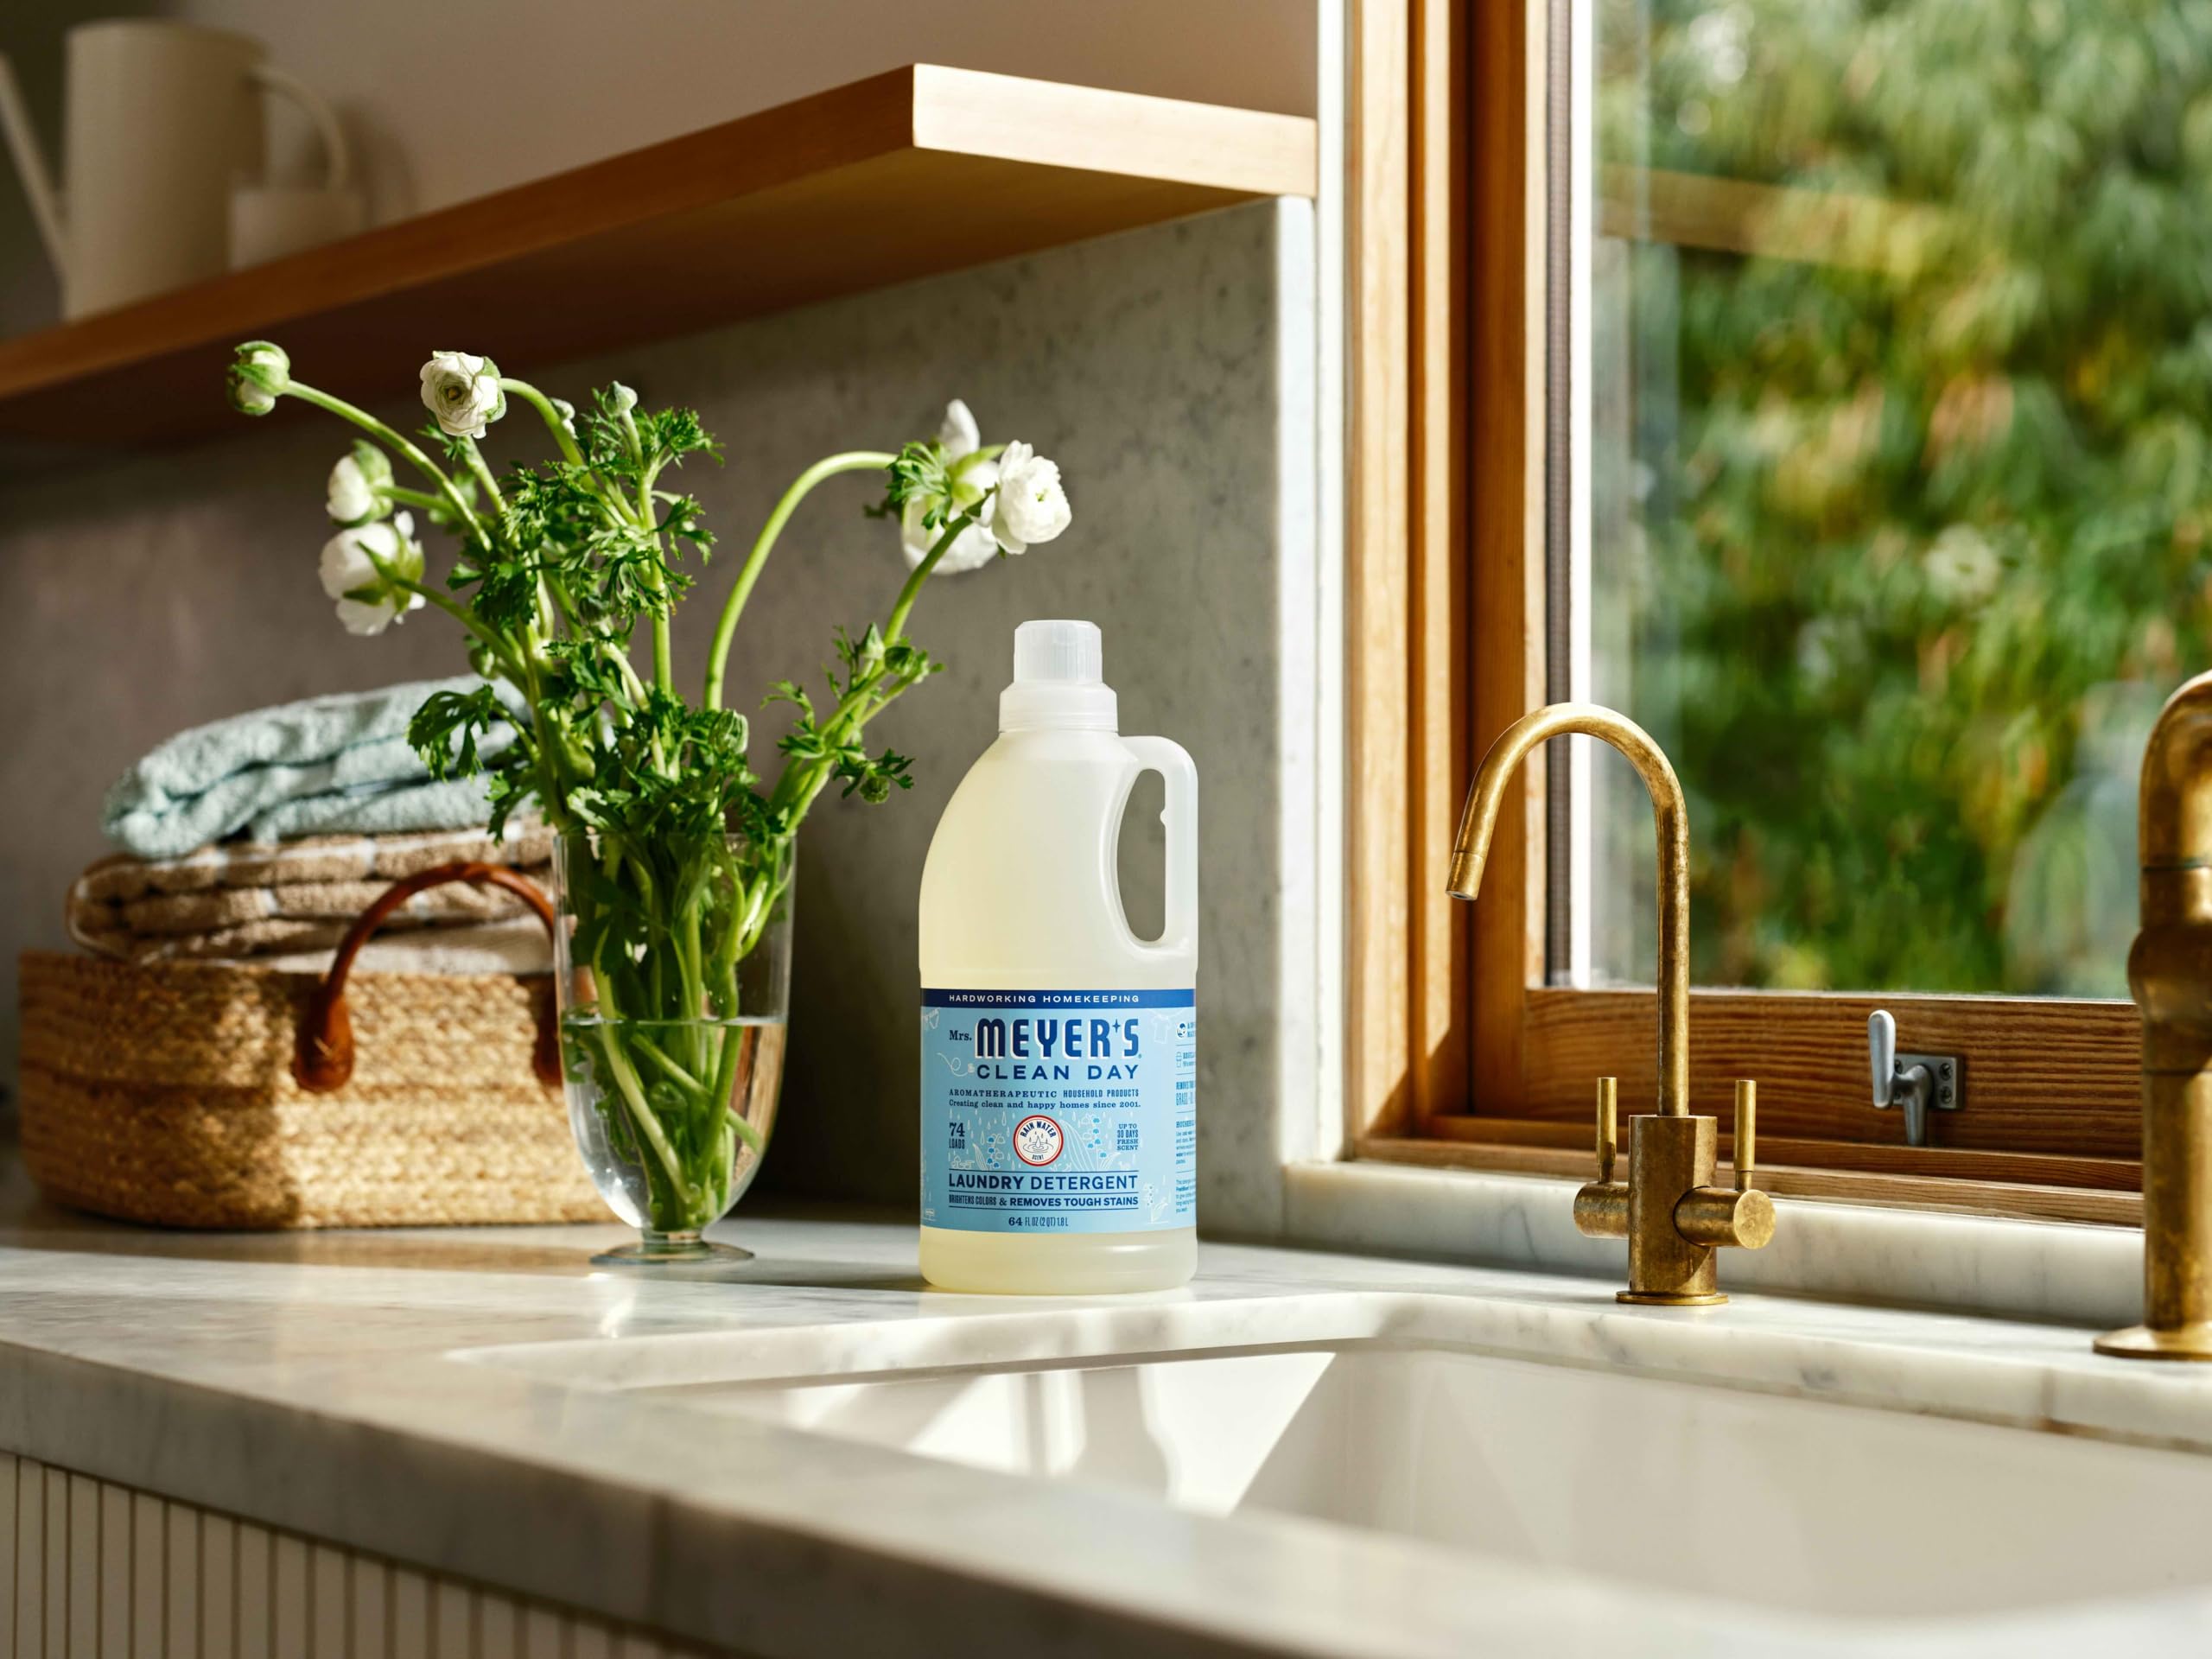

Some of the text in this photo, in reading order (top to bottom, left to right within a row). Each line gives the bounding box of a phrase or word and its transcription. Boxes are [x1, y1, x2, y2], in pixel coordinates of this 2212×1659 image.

[949, 995, 1139, 1003] HARDWORKING HOMEKEEPING
[949, 1029, 972, 1041] Mrs.
[976, 1065, 1139, 1080] CLEAN DAY
[949, 1089, 1139, 1098] AROMATHERAPEUTIC HOUSEHOLD PRODUCTS
[949, 1099, 979, 1109] Creating
[981, 1100, 1004, 1109] clean
[1027, 1101, 1056, 1110] happy
[949, 1122, 965, 1137] 74
[1020, 1121, 1057, 1138] RAIN WATER
[1125, 1129, 1139, 1138] DAYS
[949, 1138, 965, 1149] LOADS
[949, 1173, 1138, 1190] LAUNDRY DETERGENT
[949, 1194, 1139, 1206] BRIGHTENS COLORS & REMOVES TOUGH STAINS
[1008, 1217, 1023, 1226] 64
